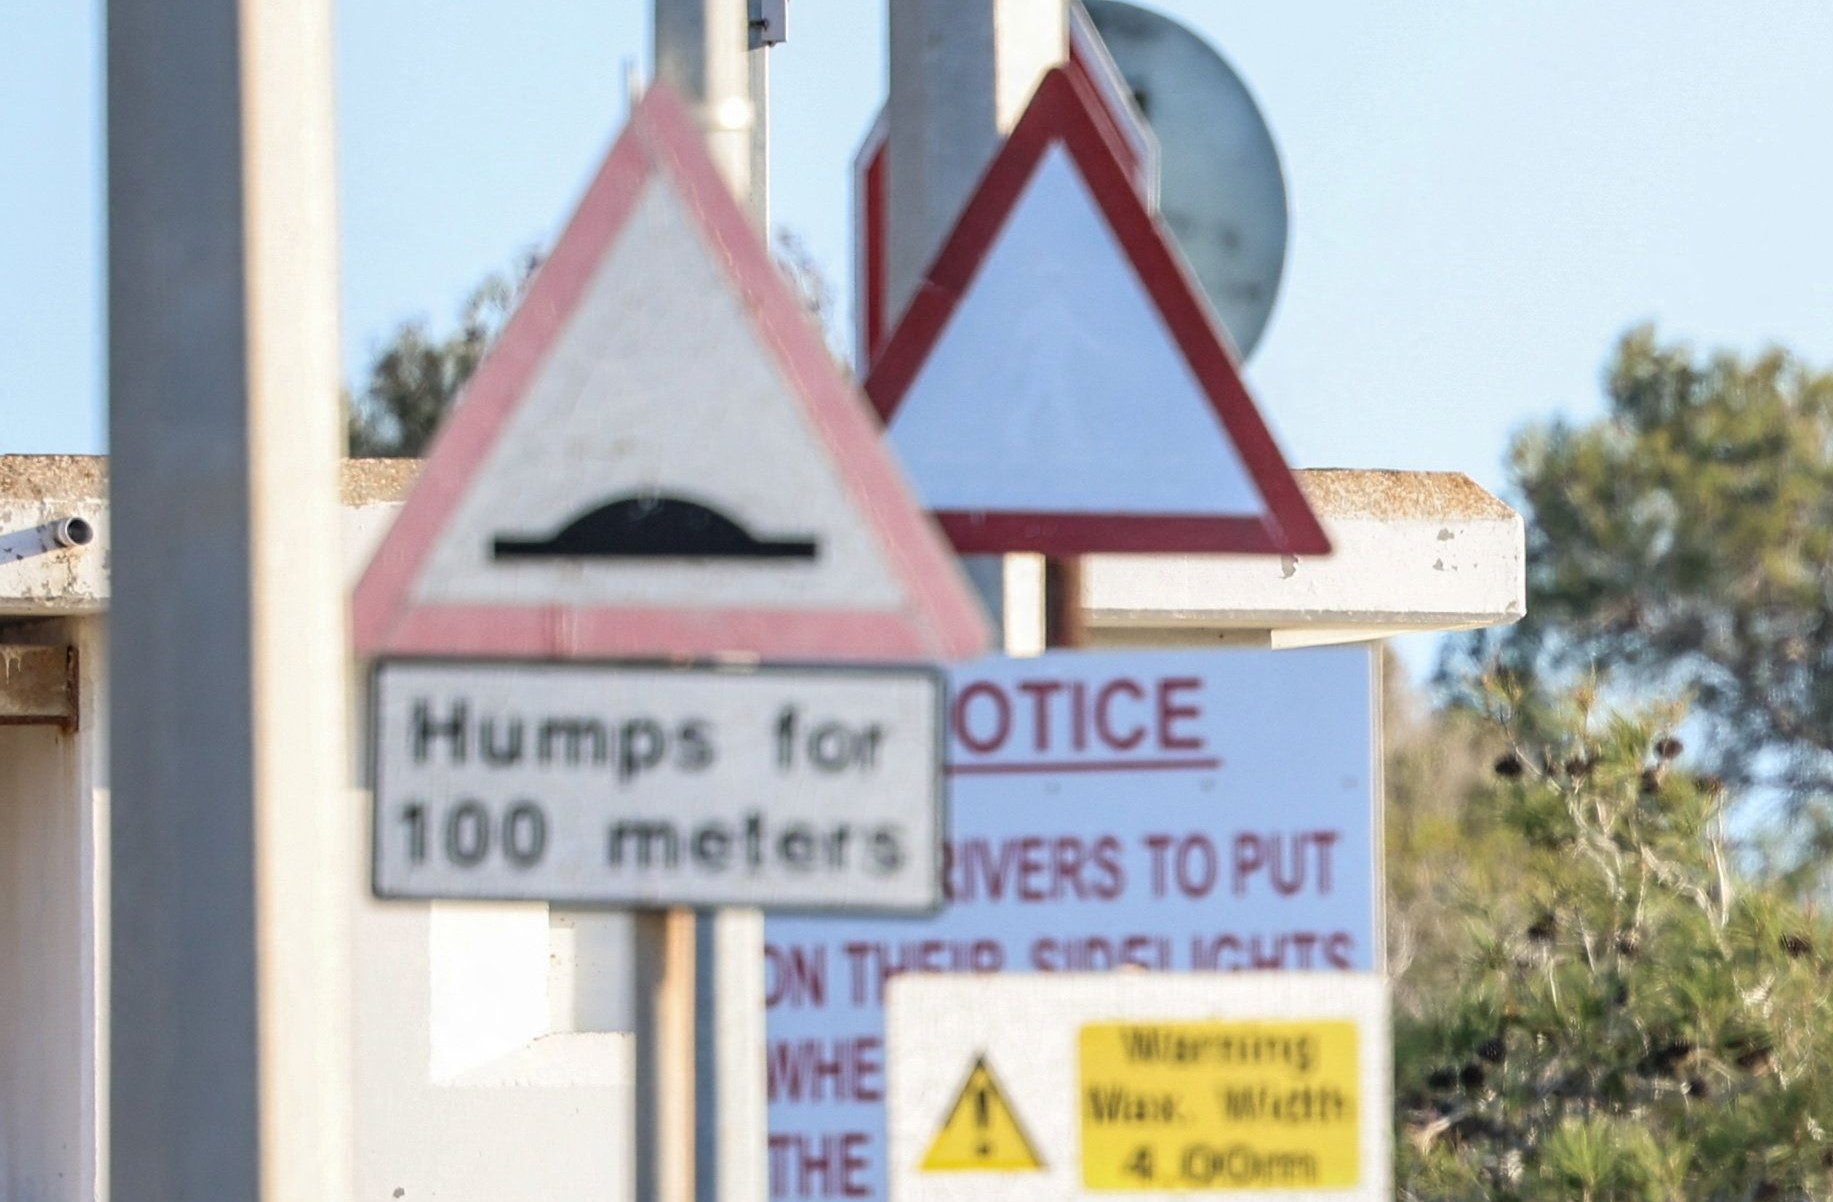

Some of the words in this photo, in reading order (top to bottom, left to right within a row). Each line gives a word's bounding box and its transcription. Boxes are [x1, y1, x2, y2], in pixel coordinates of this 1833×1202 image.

[411, 697, 715, 785] Humps
[774, 702, 885, 774] for
[951, 676, 1205, 755] OTICE
[402, 800, 547, 868] 100
[608, 810, 906, 874] meters
[942, 836, 1127, 901] IVERS
[1144, 833, 1218, 899] TO
[1231, 831, 1338, 897] PUT
[767, 1037, 884, 1102] WHE
[767, 1133, 871, 1198] THE
